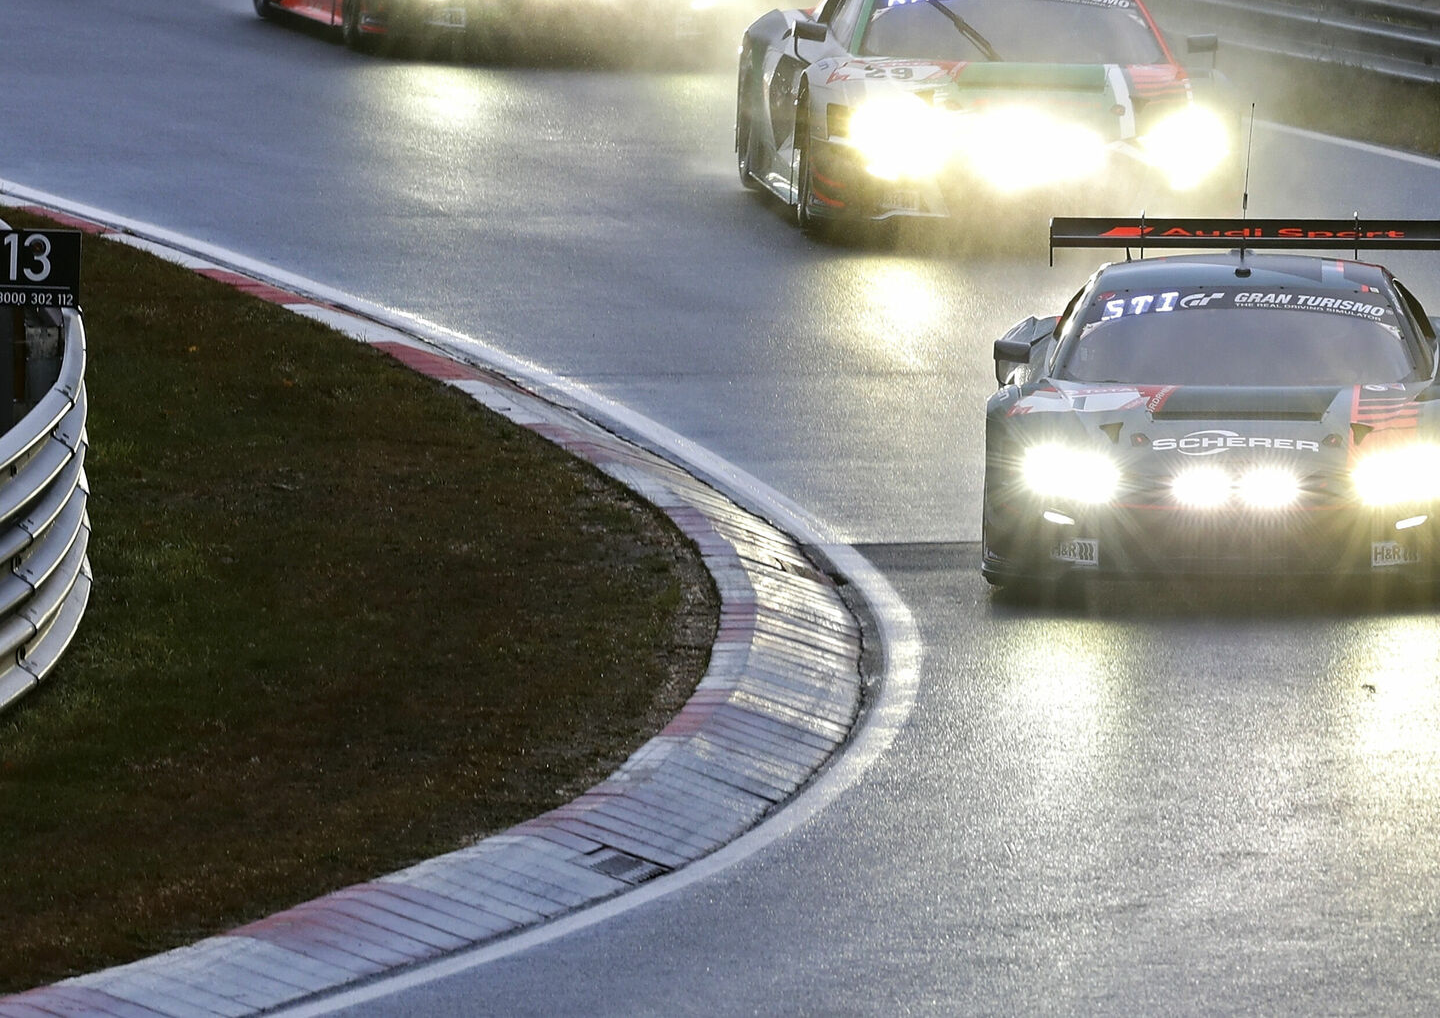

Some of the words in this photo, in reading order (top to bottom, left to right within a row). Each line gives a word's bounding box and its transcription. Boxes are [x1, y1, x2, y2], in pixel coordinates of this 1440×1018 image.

[864, 65, 914, 80] 29
[1160, 227, 1262, 237] Audi
[1278, 227, 1405, 238] Sport
[4, 233, 51, 282] 13
[31, 292, 53, 305] 302
[58, 293, 74, 306] 112
[1100, 291, 1180, 321] STI
[1234, 292, 1293, 304] GRAN
[1296, 294, 1385, 317] TURISMO
[1284, 304, 1324, 312] DRIVING
[1326, 306, 1382, 322] SIMULATOR
[1152, 436, 1320, 453] SCHERER
